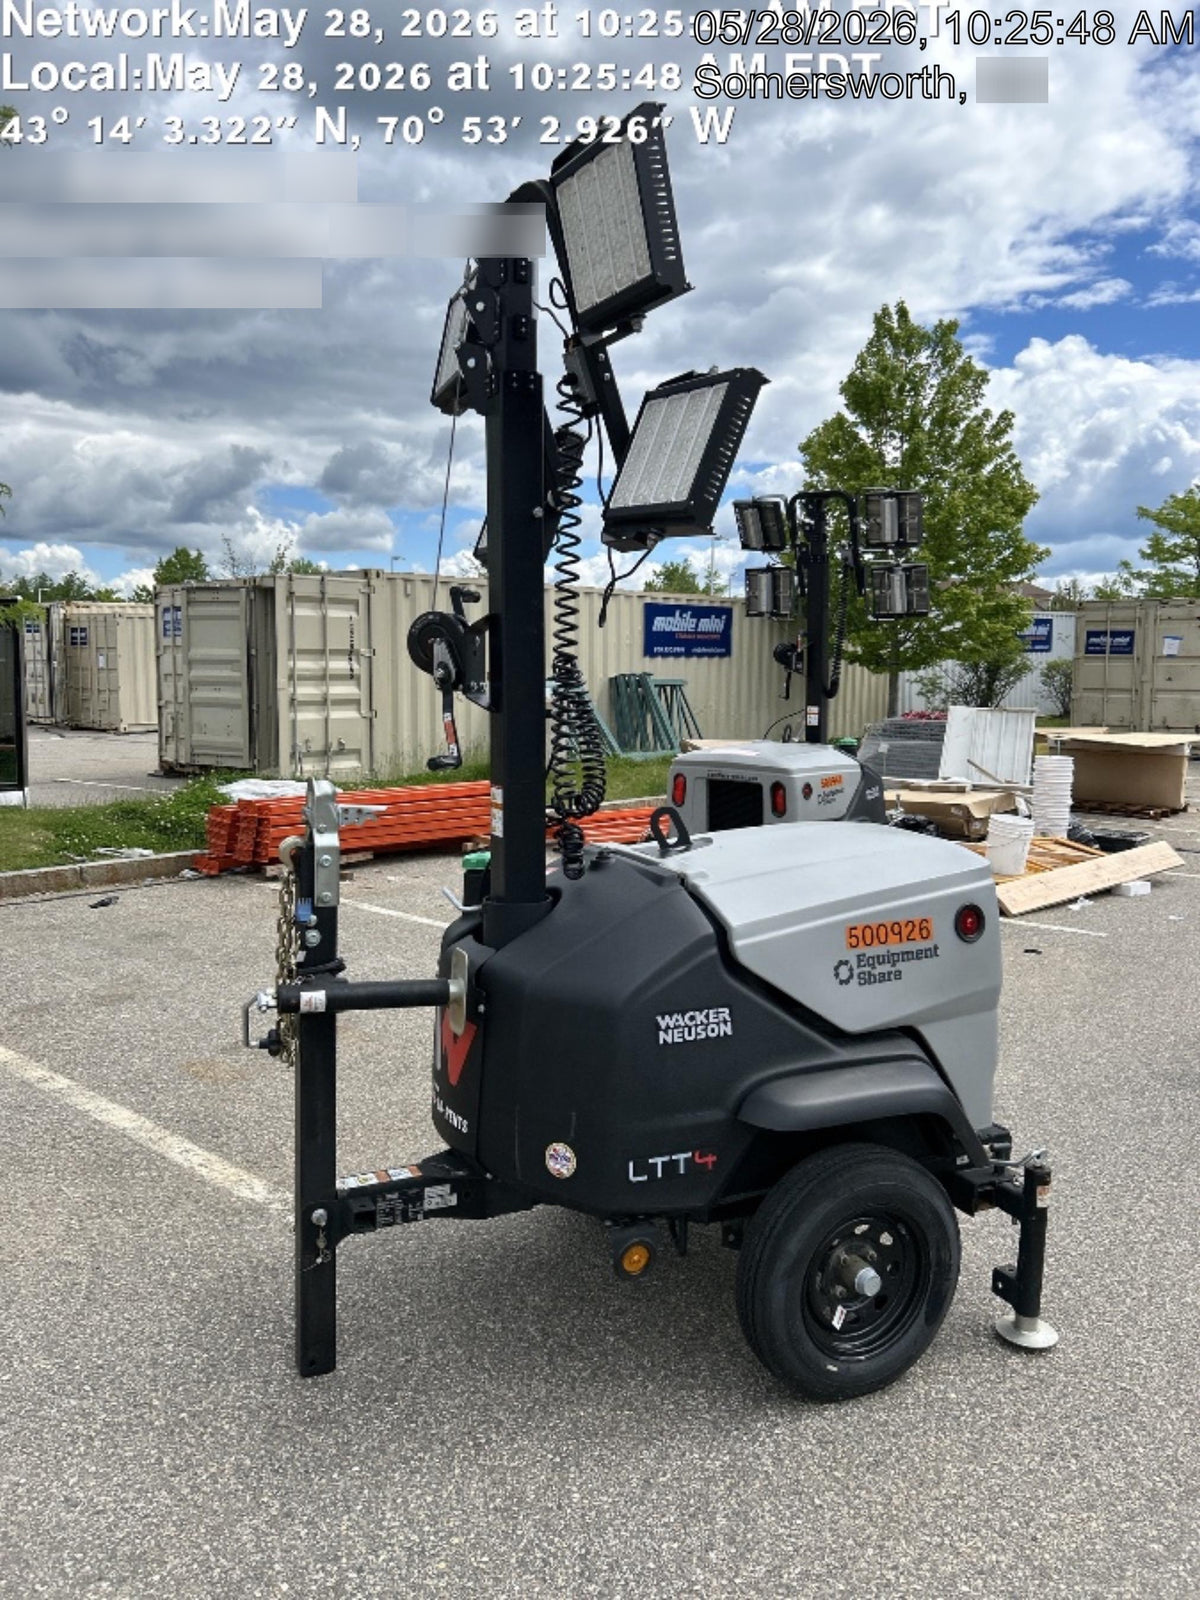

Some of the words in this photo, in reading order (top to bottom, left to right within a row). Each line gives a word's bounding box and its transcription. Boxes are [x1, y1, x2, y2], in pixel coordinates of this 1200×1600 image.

[652, 609, 698, 632] mobile
[697, 614, 727, 633] mini
[848, 918, 931, 949] 500926
[856, 943, 940, 970] Equipment
[857, 969, 903, 987] Share
[656, 1007, 732, 1031] WACKER
[658, 1021, 733, 1045] NEUSON
